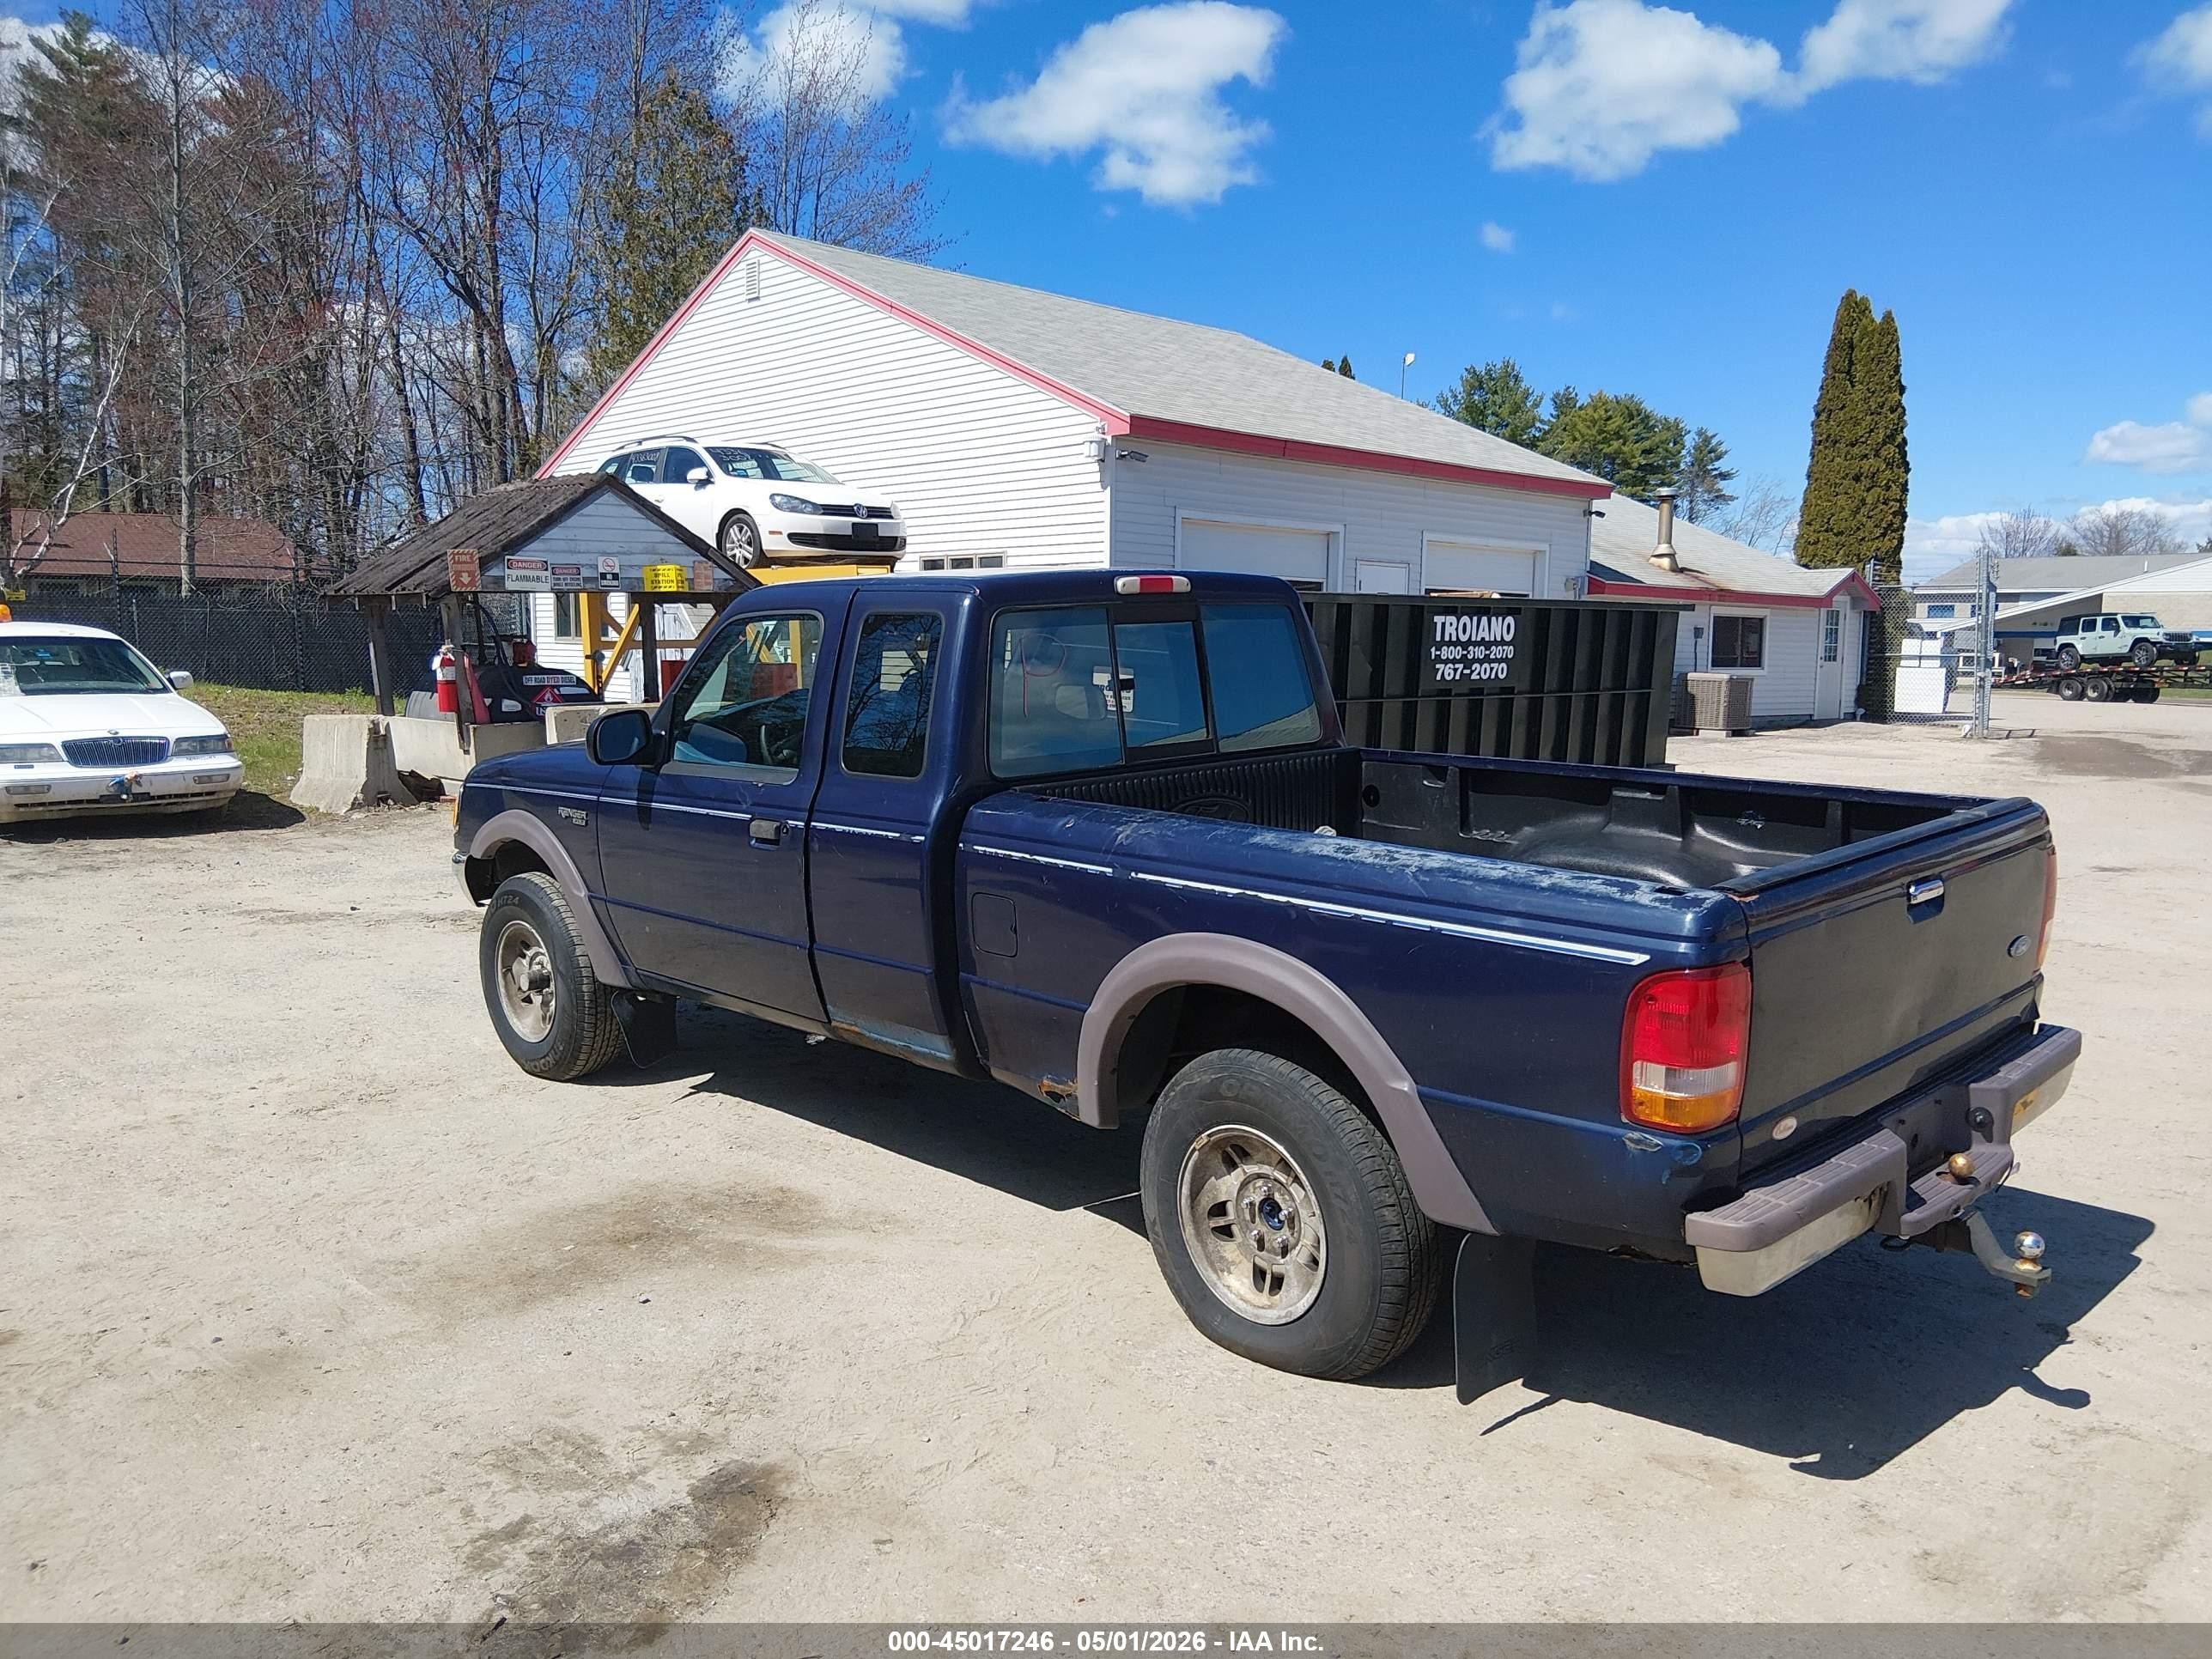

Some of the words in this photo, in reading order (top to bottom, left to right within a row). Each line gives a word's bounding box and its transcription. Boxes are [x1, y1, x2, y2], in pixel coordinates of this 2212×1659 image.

[507, 574, 550, 583] FLAMMABLE
[1433, 616, 1516, 642] TROIANO
[1430, 645, 1514, 660] 1-800-310-2070
[1435, 662, 1508, 681] 767-2070
[558, 806, 587, 819] RANGER
